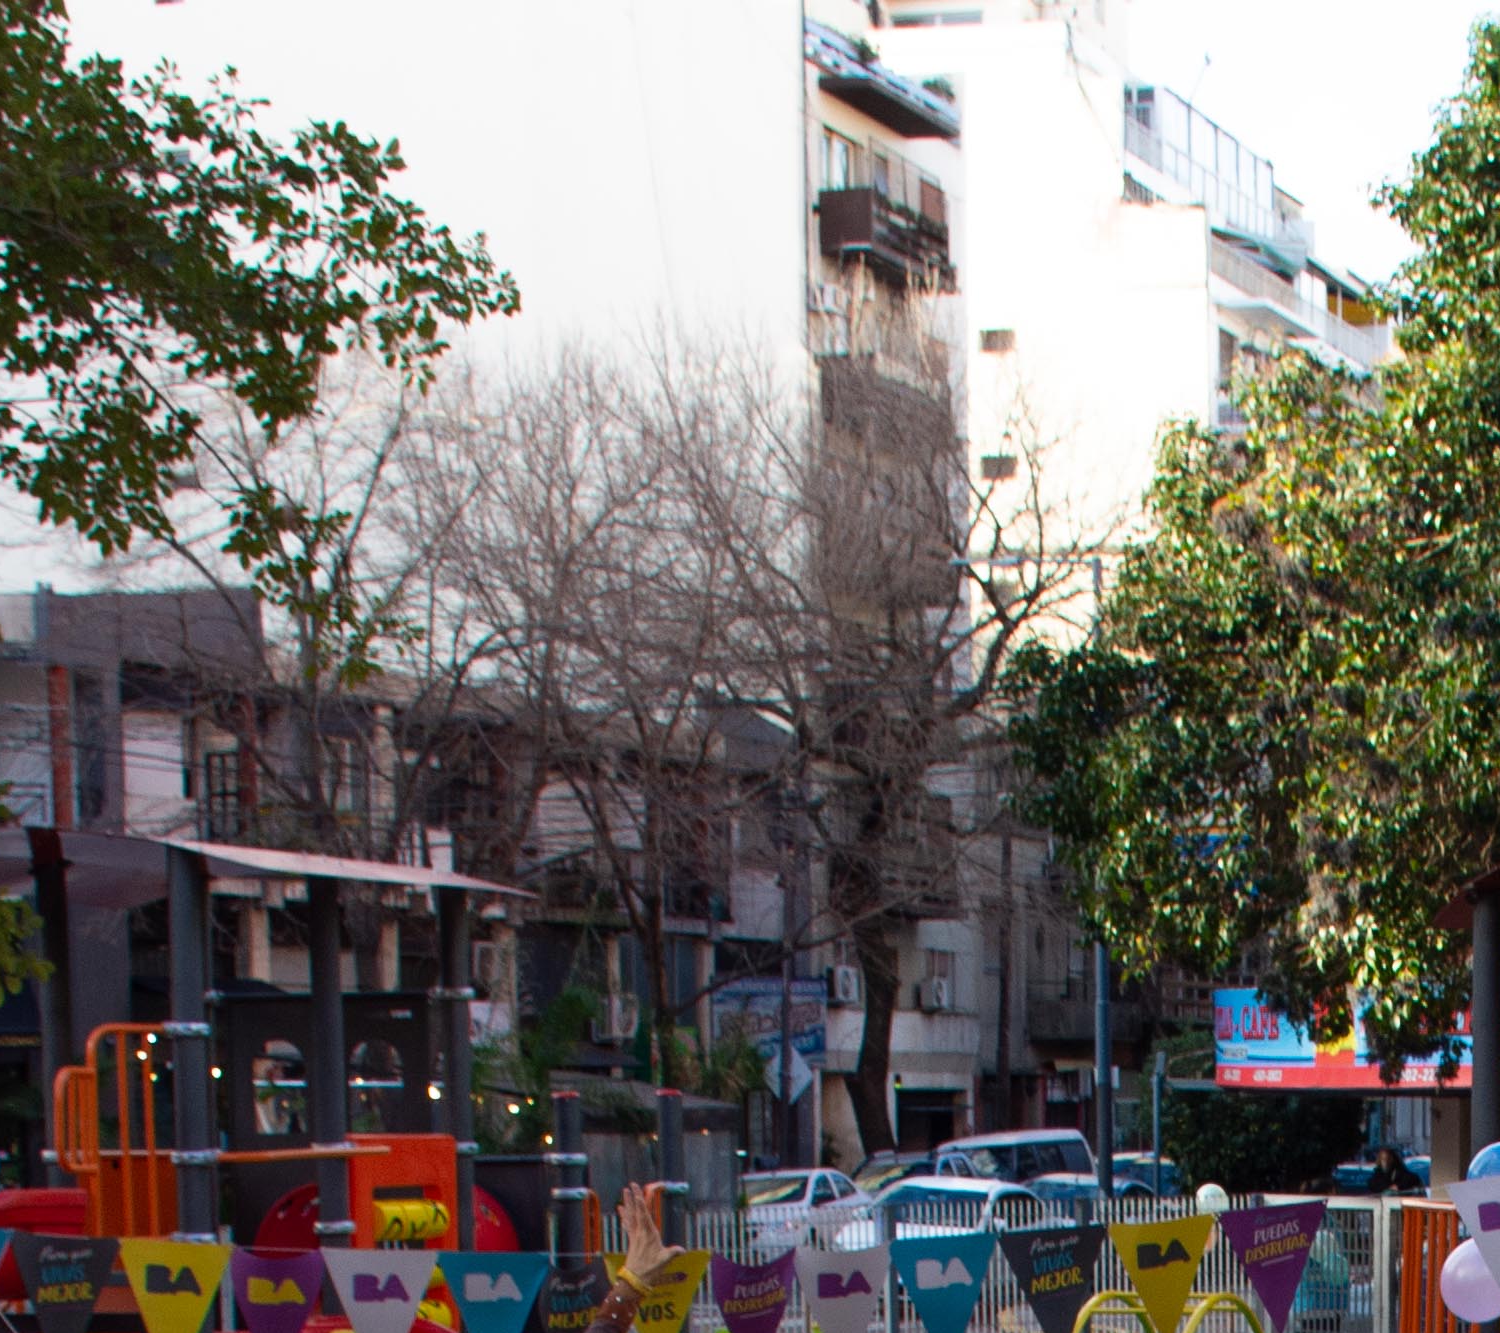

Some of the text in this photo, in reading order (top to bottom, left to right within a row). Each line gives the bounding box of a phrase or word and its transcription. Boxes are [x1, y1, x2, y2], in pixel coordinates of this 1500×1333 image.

[1254, 1219, 1300, 1246] PUEDAS
[1033, 1251, 1074, 1276] VIVAS
[1136, 1238, 1191, 1270] BA
[145, 1263, 202, 1296] BA
[353, 1273, 411, 1303] BA
[463, 1272, 524, 1302] BA
[817, 1270, 874, 1298] BA
[915, 1257, 973, 1290] BA
[246, 1276, 306, 1305] BA
